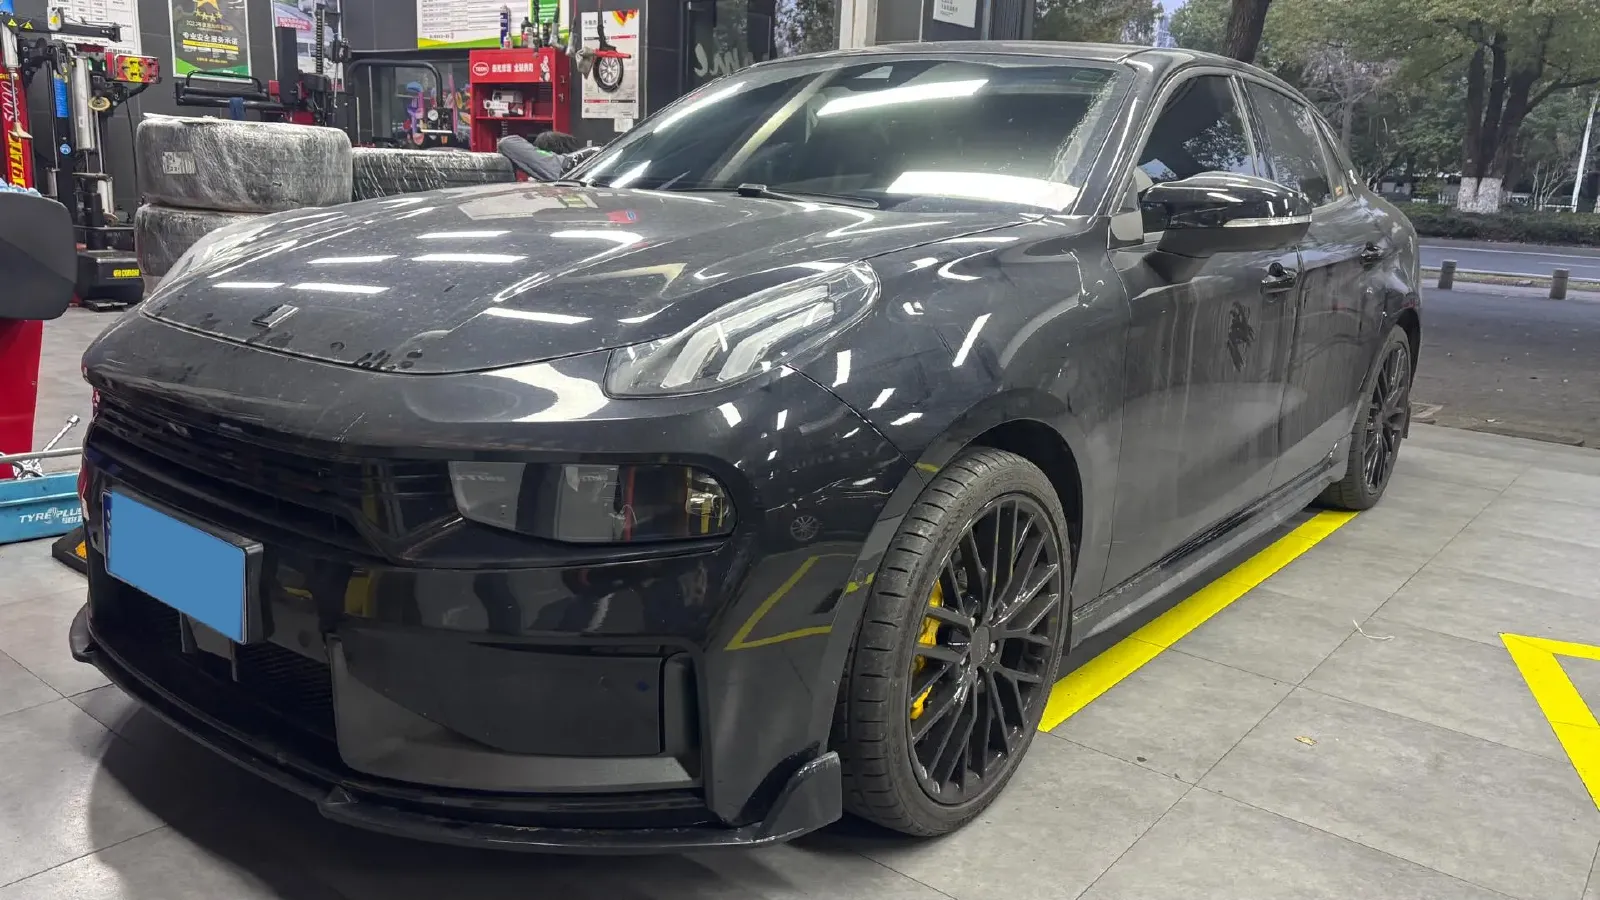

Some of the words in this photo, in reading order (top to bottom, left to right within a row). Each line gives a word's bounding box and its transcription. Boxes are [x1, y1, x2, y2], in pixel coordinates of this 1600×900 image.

[182, 31, 238, 45] 专业安全服务承诺
